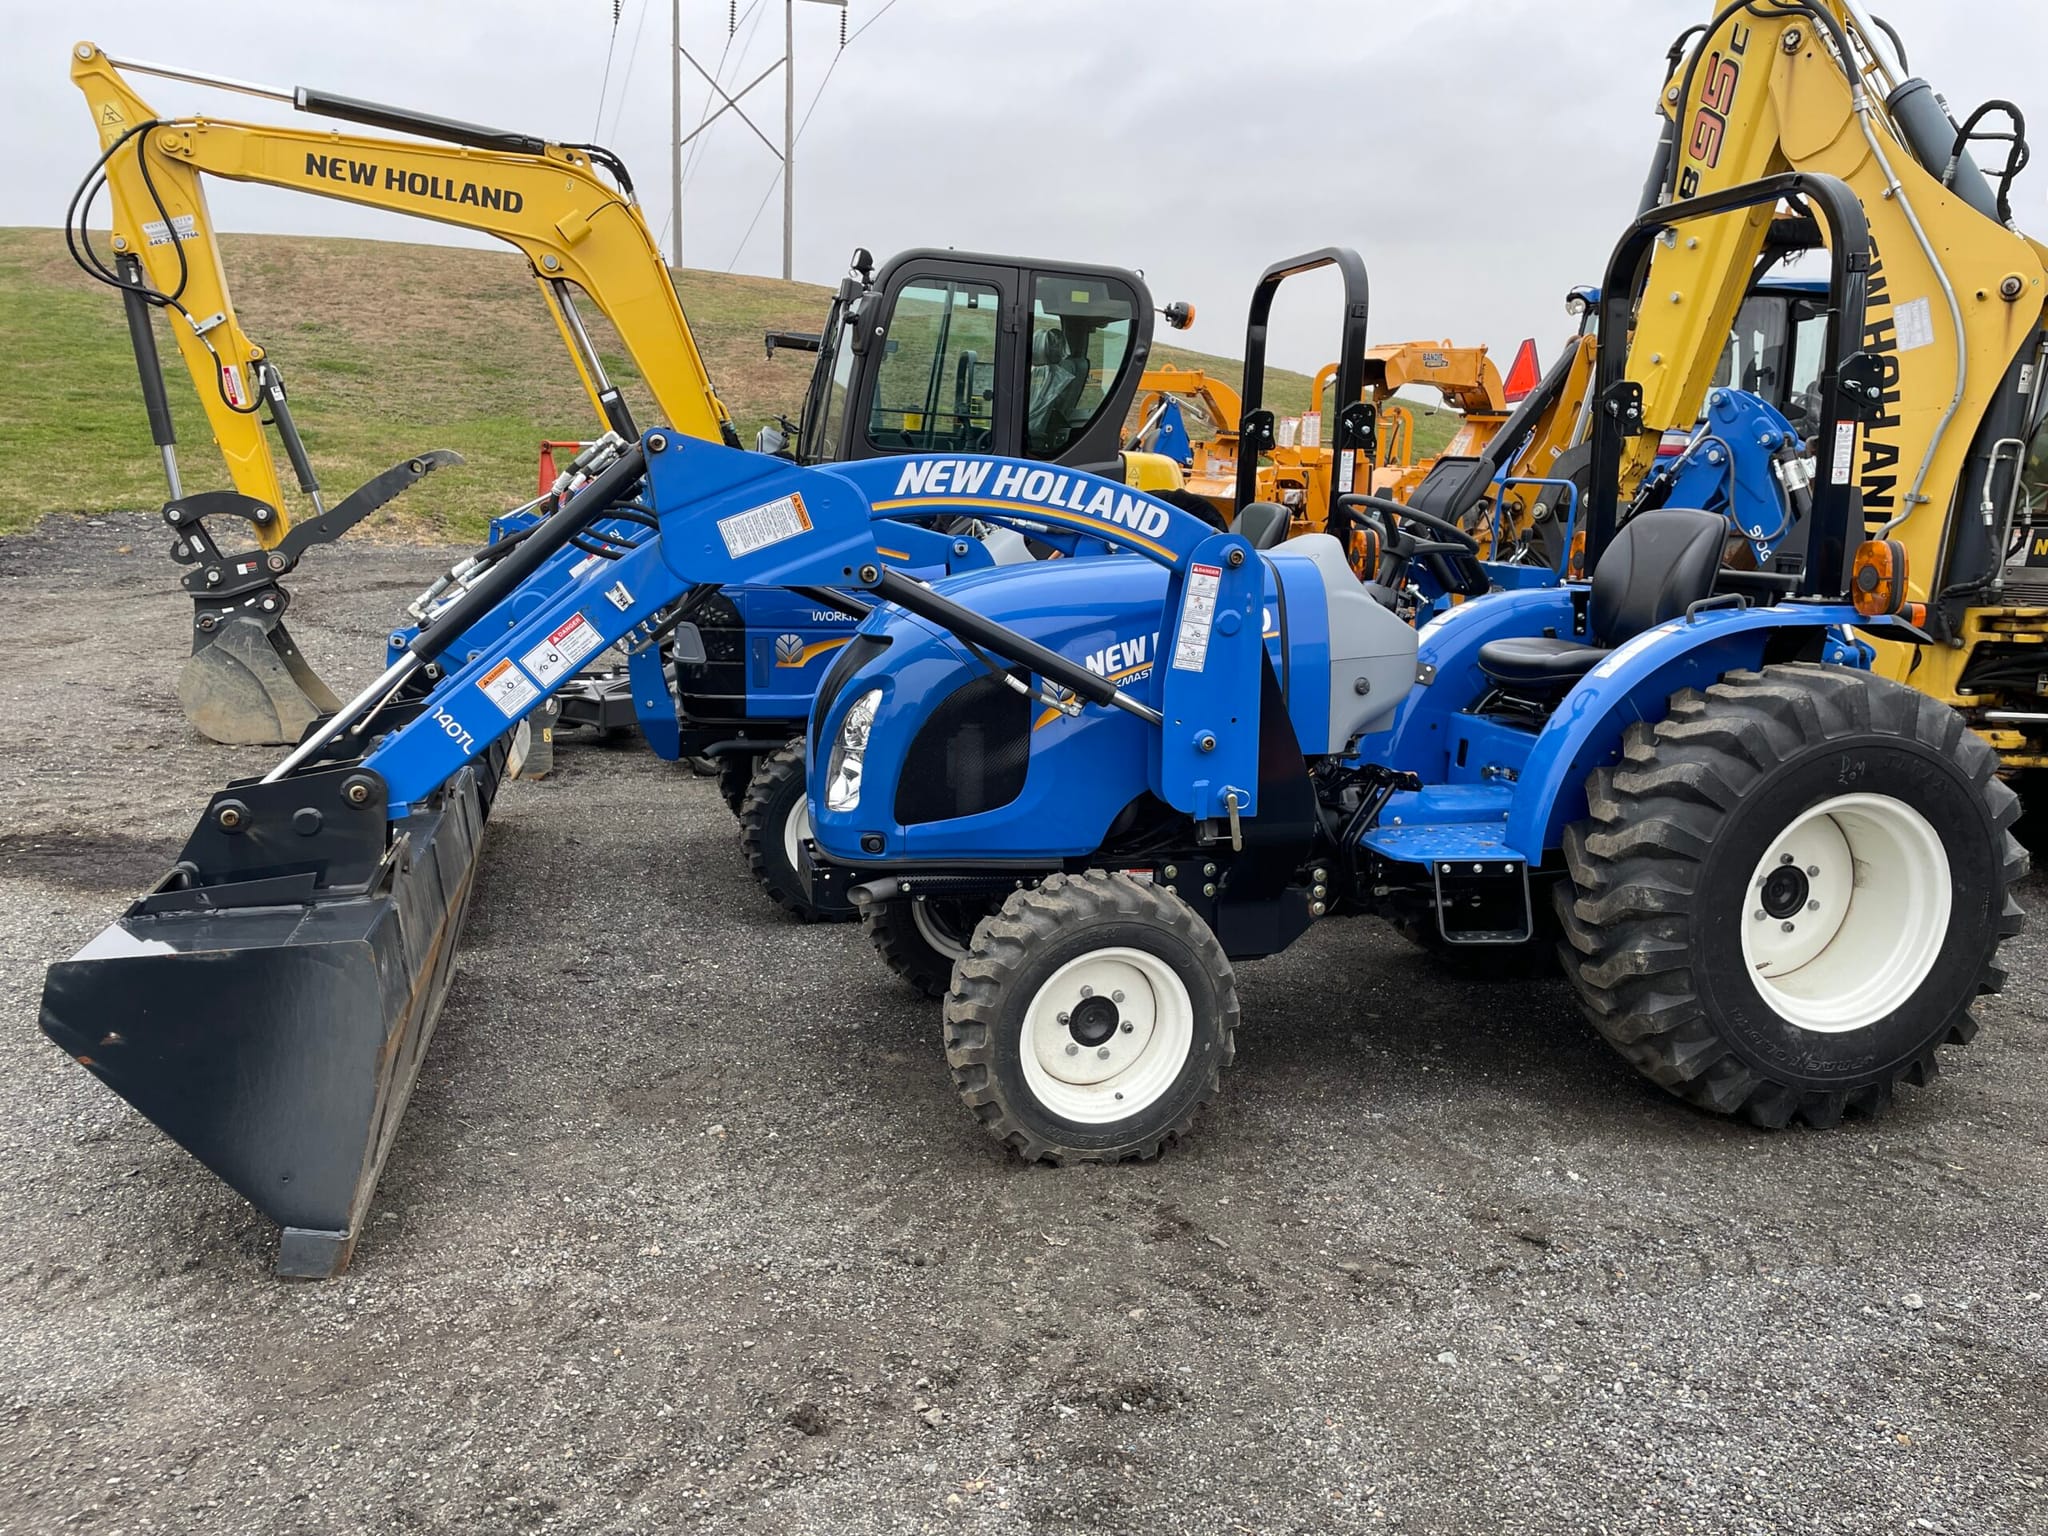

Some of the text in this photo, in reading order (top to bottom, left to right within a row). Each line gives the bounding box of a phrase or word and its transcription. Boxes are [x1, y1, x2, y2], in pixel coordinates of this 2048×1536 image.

[305, 152, 524, 214] NEW HOLLAND
[1422, 352, 1443, 361] BANDIT
[894, 460, 1171, 539] NEW HOLLAND
[1197, 566, 1221, 576] DANGER
[556, 615, 582, 638] DANGER
[1085, 634, 1147, 678] NEW
[431, 705, 475, 756] 140TL
